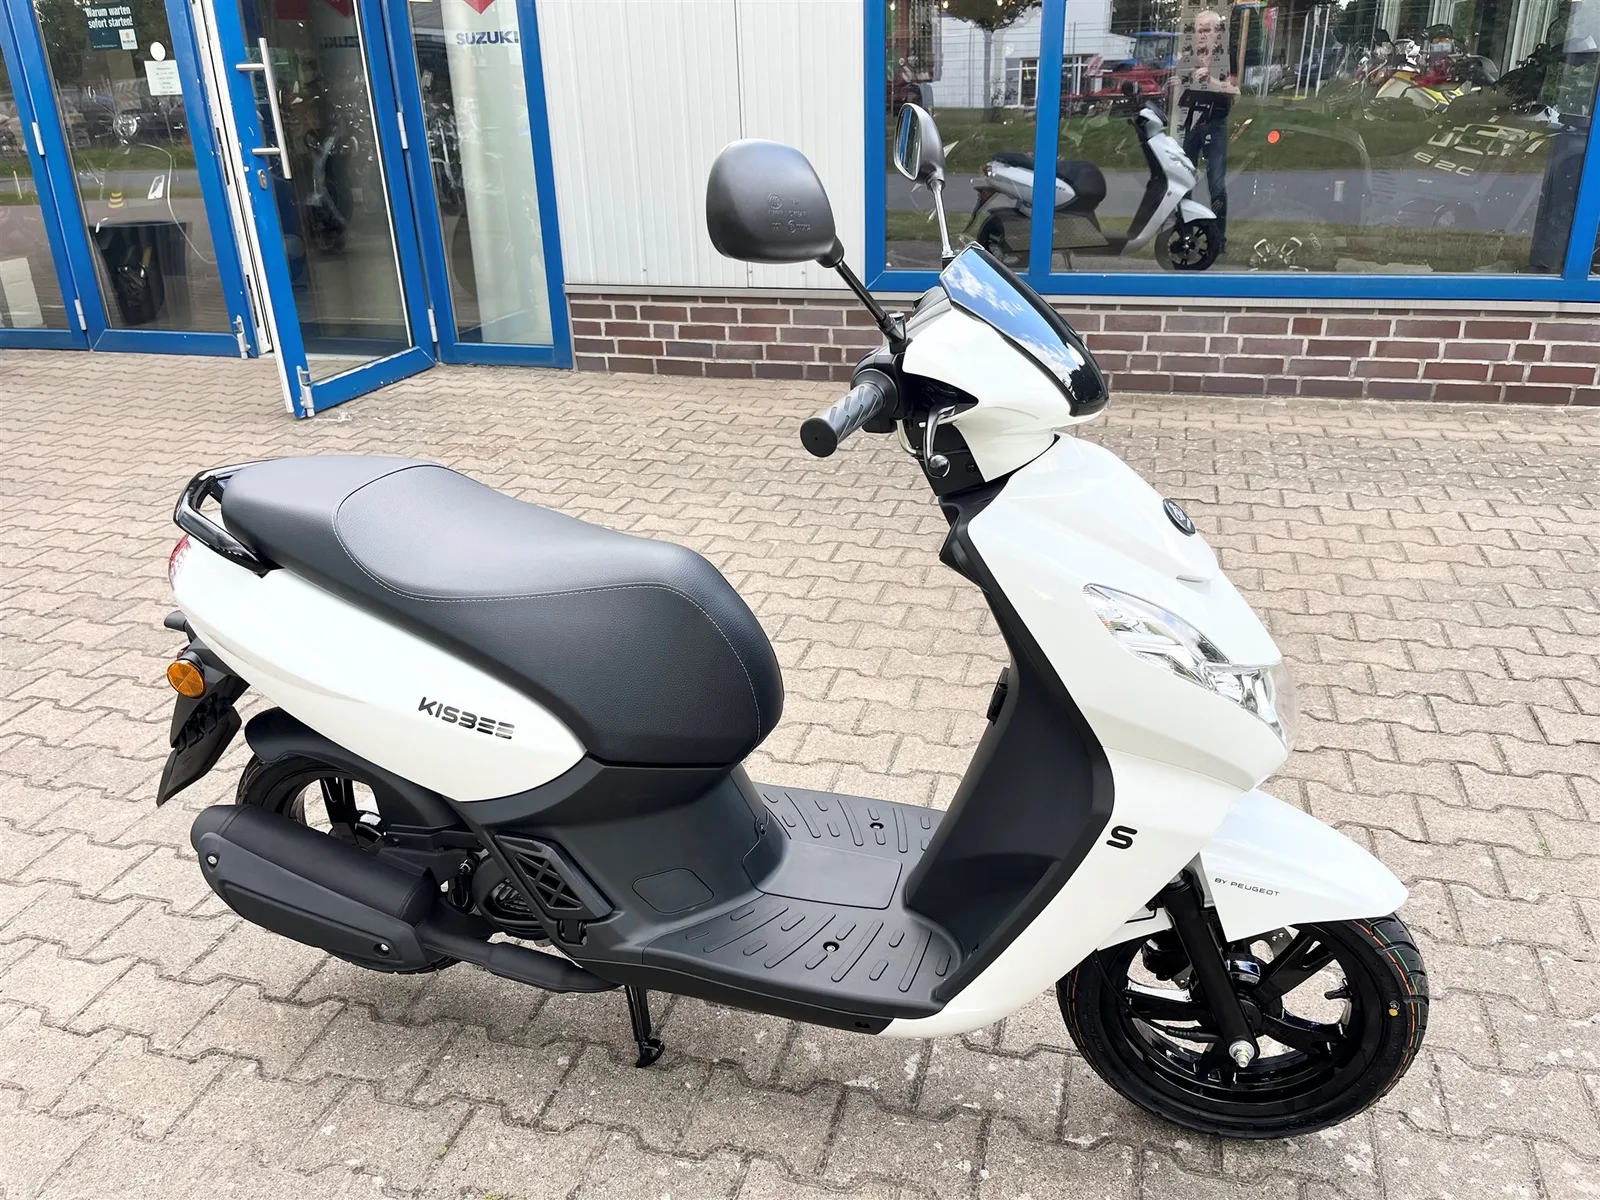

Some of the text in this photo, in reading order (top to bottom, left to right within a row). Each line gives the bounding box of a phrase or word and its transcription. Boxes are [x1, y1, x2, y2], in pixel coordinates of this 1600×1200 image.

[84, 6, 131, 17] Warum warten
[88, 16, 134, 29] sofort starten!
[456, 31, 519, 45] SUZUKI
[418, 696, 515, 740] KISBEE
[1106, 825, 1138, 850] S
[1230, 881, 1280, 897] PEUGEOT
